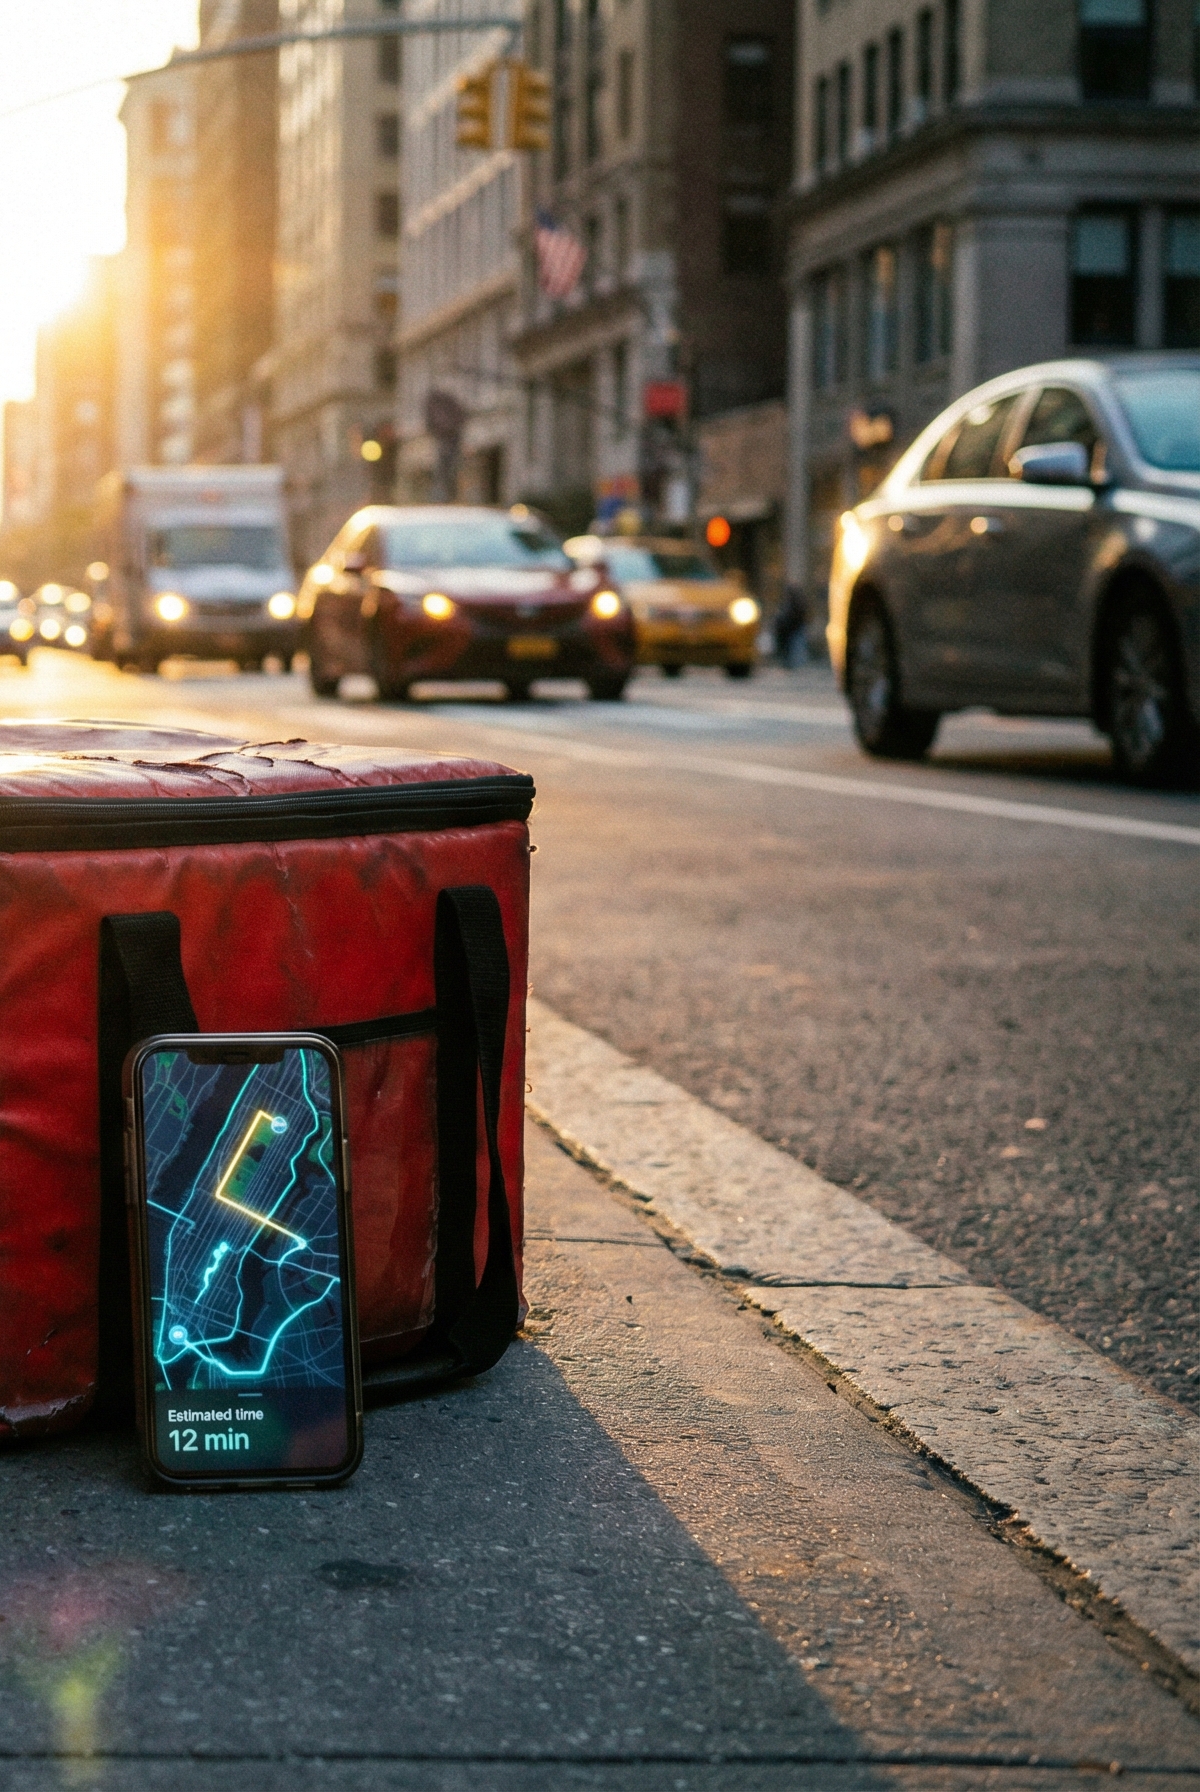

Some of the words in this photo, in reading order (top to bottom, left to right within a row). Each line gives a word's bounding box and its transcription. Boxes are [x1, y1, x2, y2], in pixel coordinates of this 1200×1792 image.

[168, 1408, 232, 1422] Estimated
[235, 1408, 264, 1421] time
[169, 1428, 198, 1451] 12
[204, 1428, 250, 1450] min
